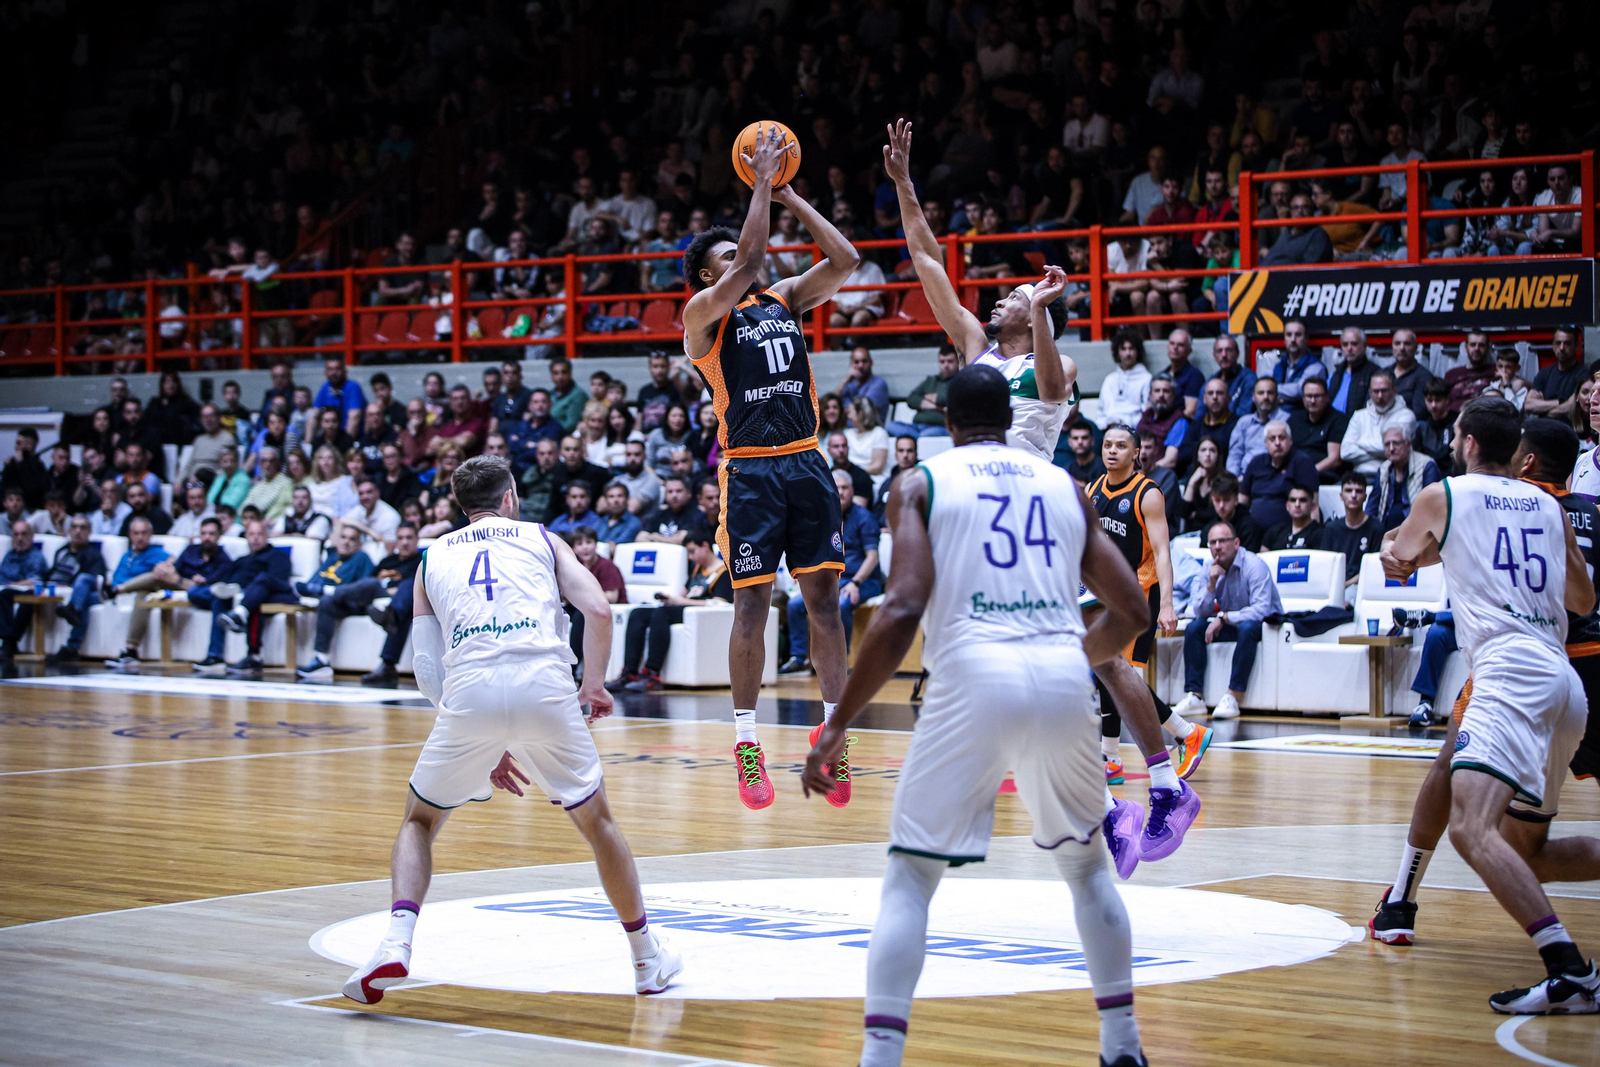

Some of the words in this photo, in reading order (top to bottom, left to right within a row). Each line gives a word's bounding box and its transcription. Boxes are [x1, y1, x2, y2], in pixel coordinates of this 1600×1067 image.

[1283, 282, 1385, 317] #PROUD
[1388, 280, 1421, 315] TO
[1424, 278, 1460, 313] BE
[1463, 274, 1579, 311] ORANGE!
[758, 336, 795, 374] 10
[967, 461, 1035, 478] THOMAS
[1484, 494, 1540, 512] KRAVISH
[447, 527, 519, 547] KALINOSKI
[977, 492, 1056, 569] 34
[735, 555, 761, 567] SUPER
[735, 562, 763, 574] CARGO
[1493, 527, 1547, 593] 45
[468, 549, 499, 601] 4
[1284, 631, 1291, 643] 2
